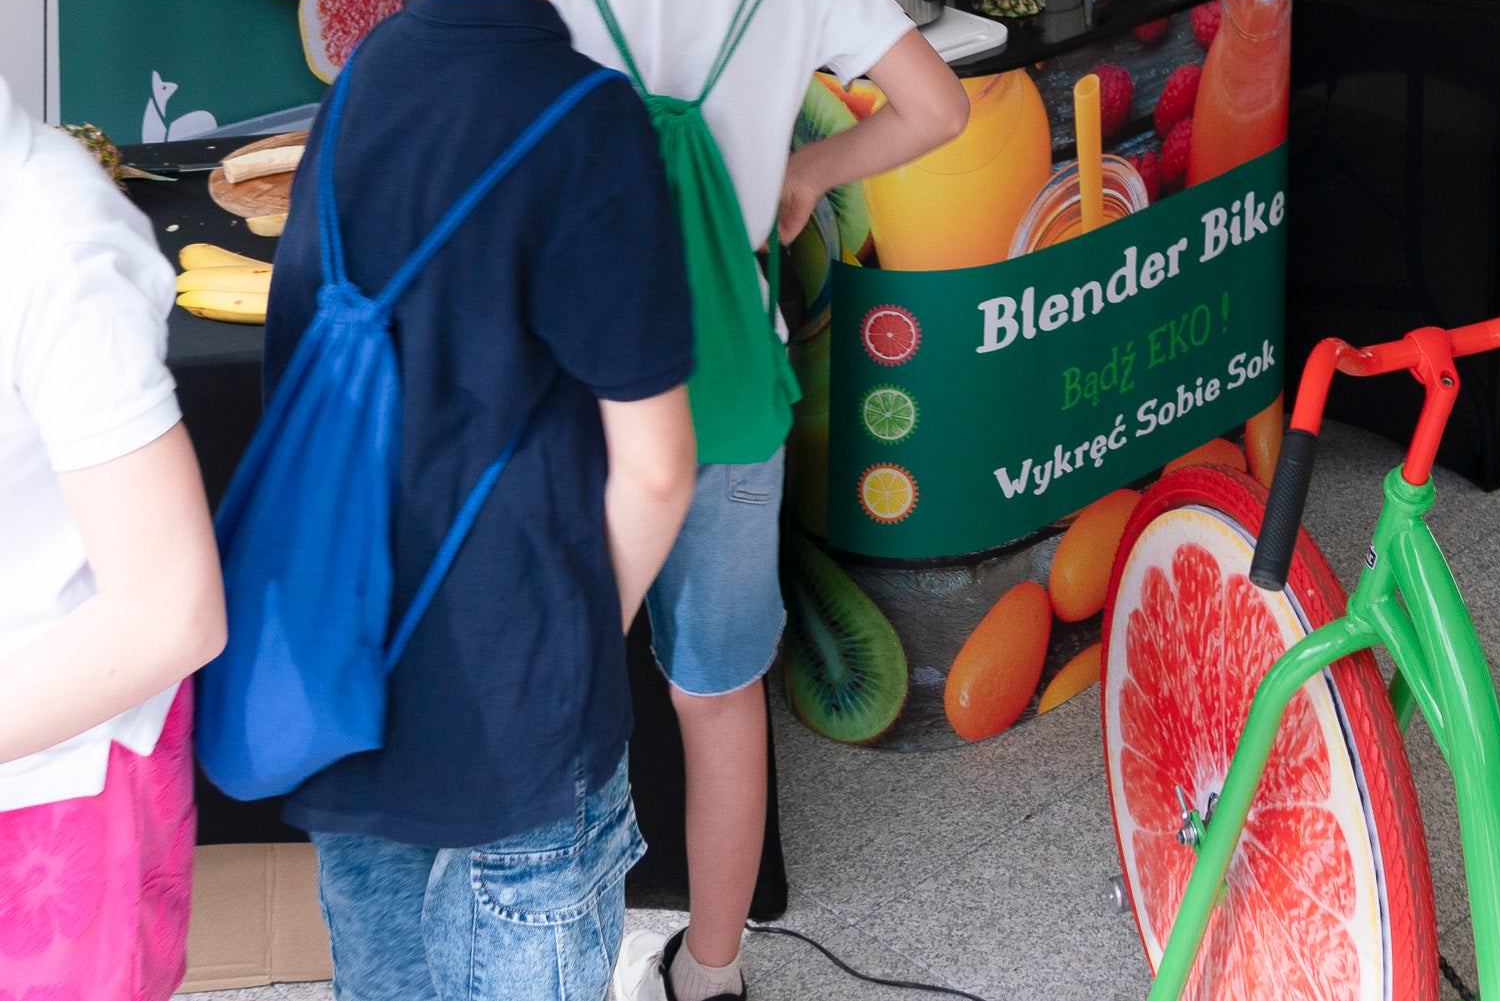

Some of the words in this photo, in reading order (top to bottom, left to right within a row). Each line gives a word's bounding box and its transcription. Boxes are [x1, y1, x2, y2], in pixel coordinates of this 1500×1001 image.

[976, 237, 1188, 354] Blender
[1199, 191, 1285, 263] Bike
[993, 414, 1127, 498] Wykręć
[1135, 377, 1220, 437] Sobie
[1227, 339, 1275, 390] Sok
[1061, 340, 1136, 410] Bądź
[1148, 304, 1211, 369] EKO
